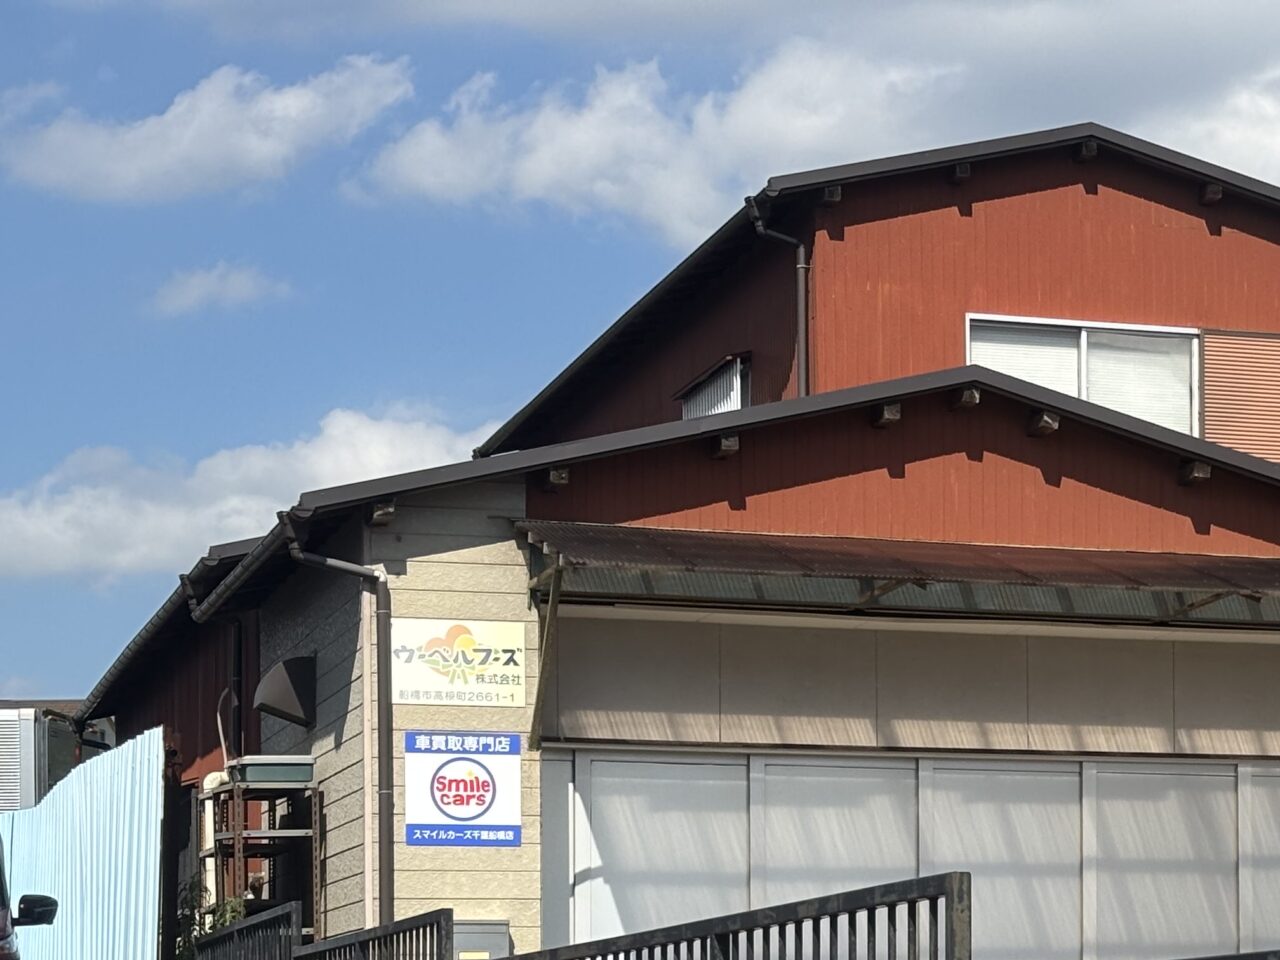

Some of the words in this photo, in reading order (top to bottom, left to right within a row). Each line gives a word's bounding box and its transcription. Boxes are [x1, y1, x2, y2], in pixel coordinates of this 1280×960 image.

[475, 673, 522, 686] 株式会社
[414, 735, 511, 752] 車買取専門店
[436, 776, 490, 793] Smile
[440, 793, 486, 806] cars
